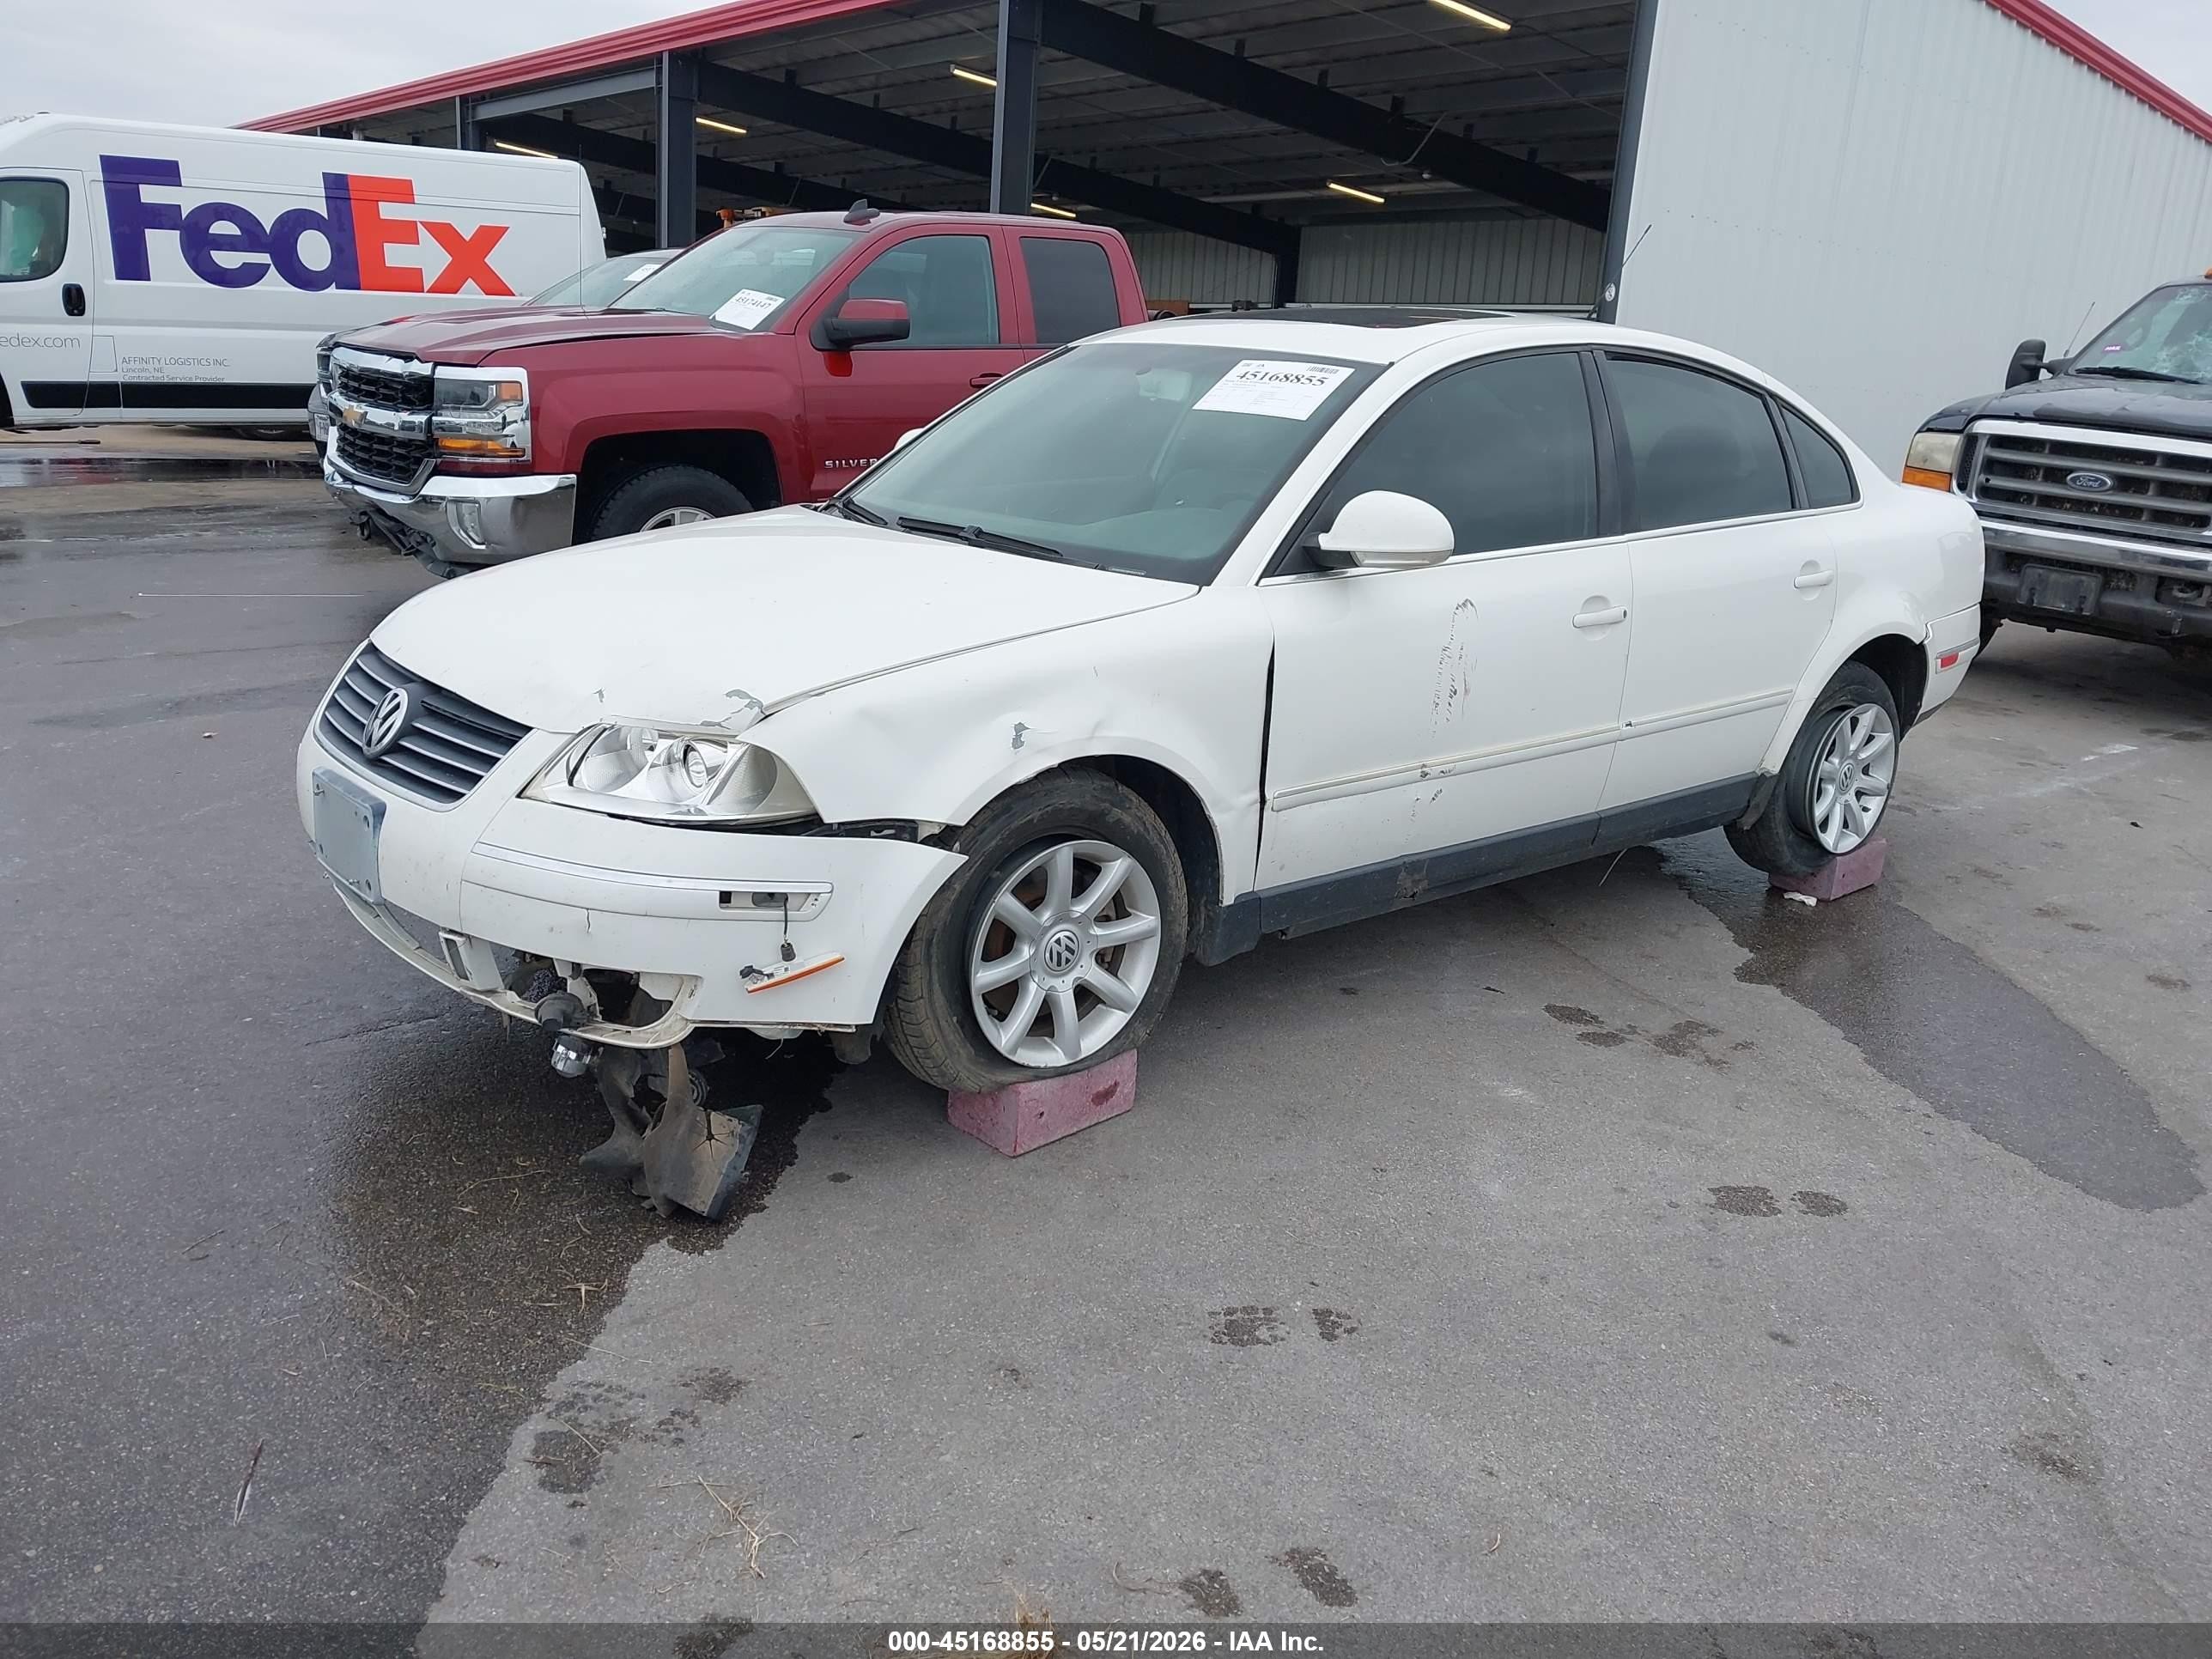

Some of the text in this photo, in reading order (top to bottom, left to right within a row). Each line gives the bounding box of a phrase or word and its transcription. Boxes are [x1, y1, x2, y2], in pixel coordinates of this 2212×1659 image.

[99, 155, 516, 296] FedEx
[121, 356, 162, 365] AFFINITY
[164, 357, 211, 367] LOGISTICS
[1237, 370, 1329, 386] 45168855
[2076, 476, 2102, 488] Ford
